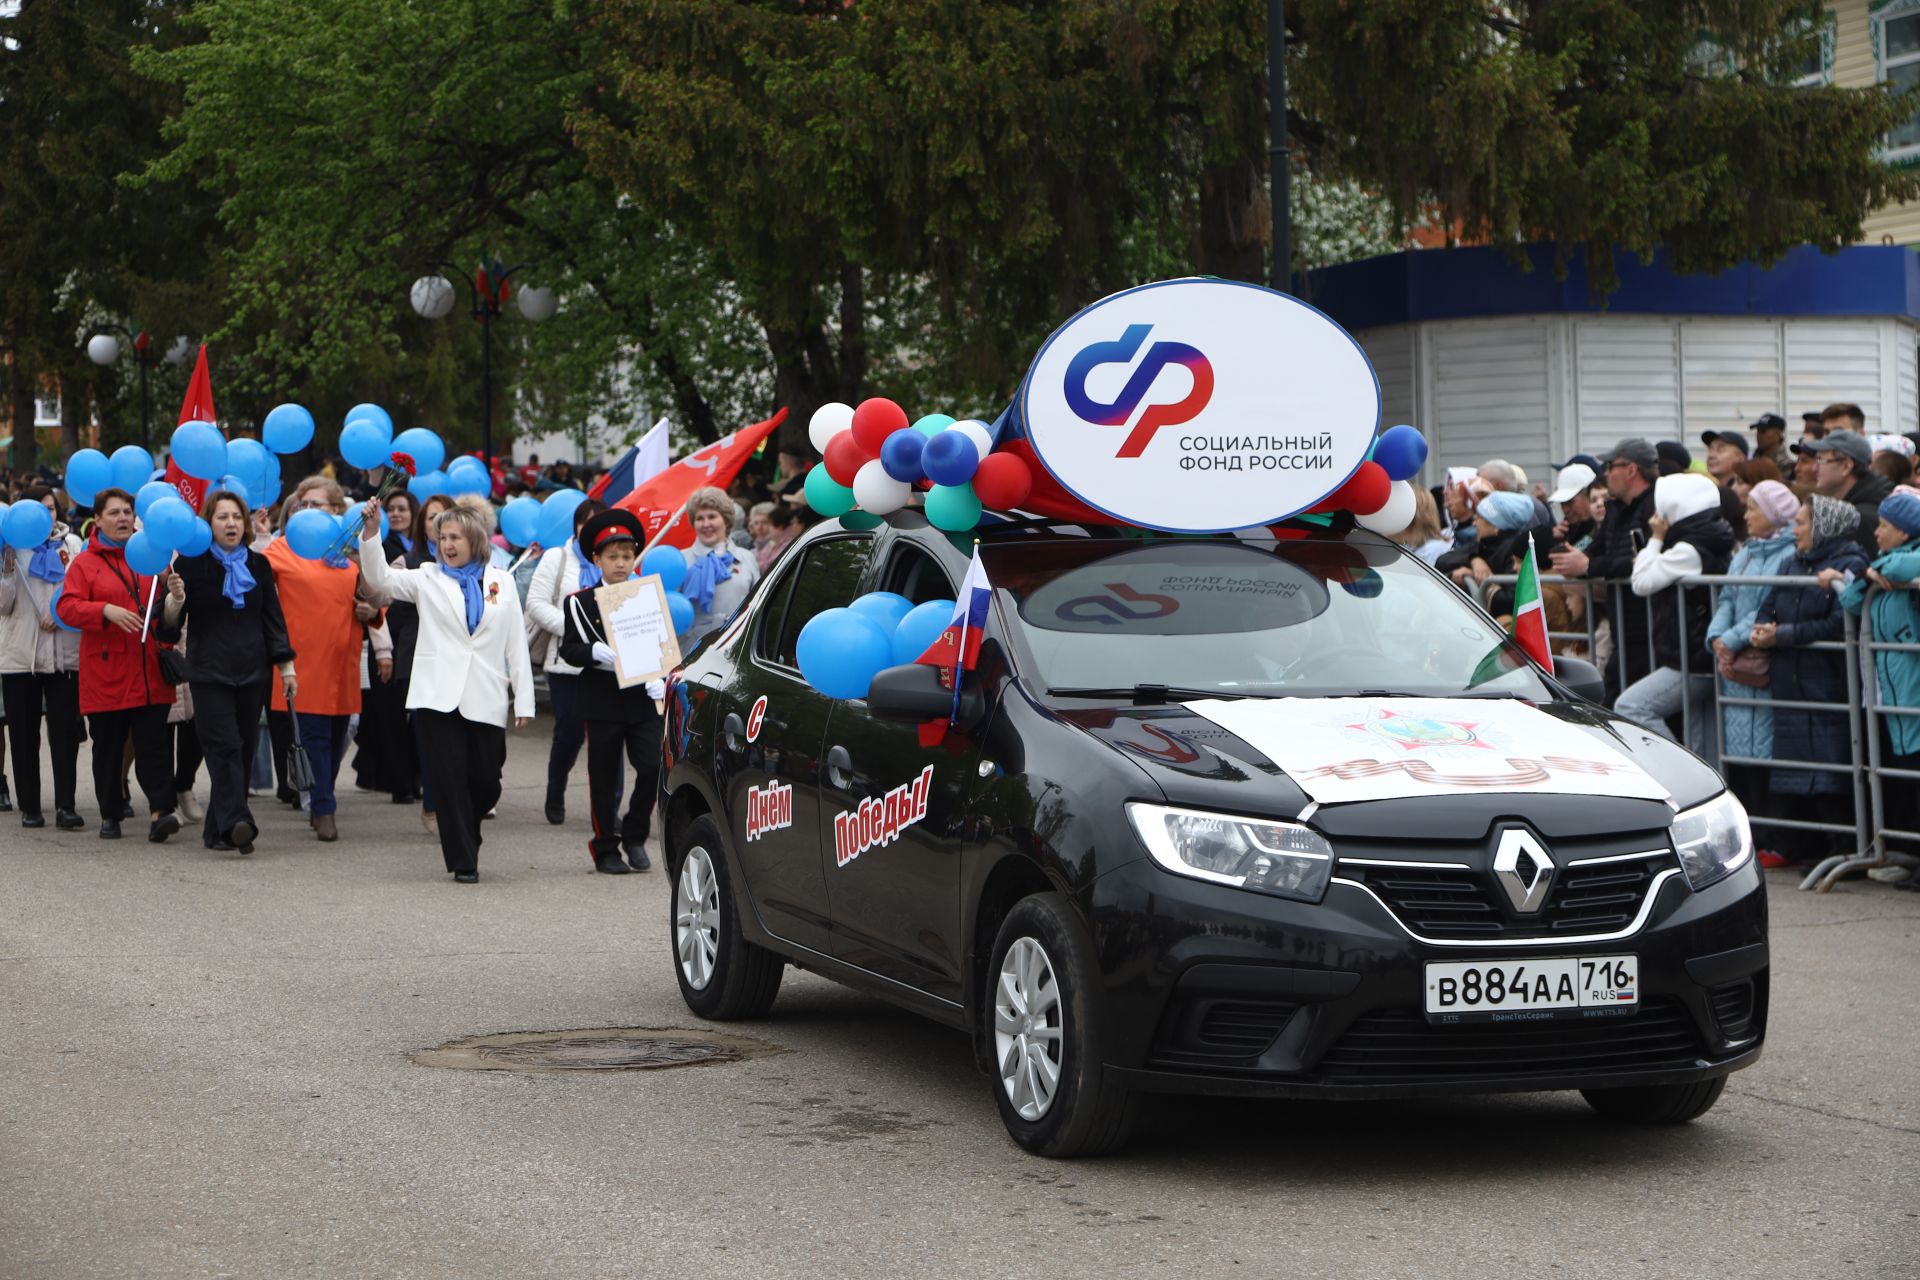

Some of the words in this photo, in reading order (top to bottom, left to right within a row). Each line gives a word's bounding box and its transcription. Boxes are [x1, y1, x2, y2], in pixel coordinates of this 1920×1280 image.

[1179, 432, 1332, 453] СОЦИАЛЬНЫЙ
[1179, 455, 1243, 472] ФОНД
[1250, 455, 1332, 470] РОССИИ
[747, 695, 767, 743] С
[747, 780, 792, 841] Днём
[835, 764, 934, 867] Победы!
[1439, 967, 1575, 1006] В884АА
[1581, 961, 1629, 990] 716
[1592, 991, 1616, 1000] RUS
